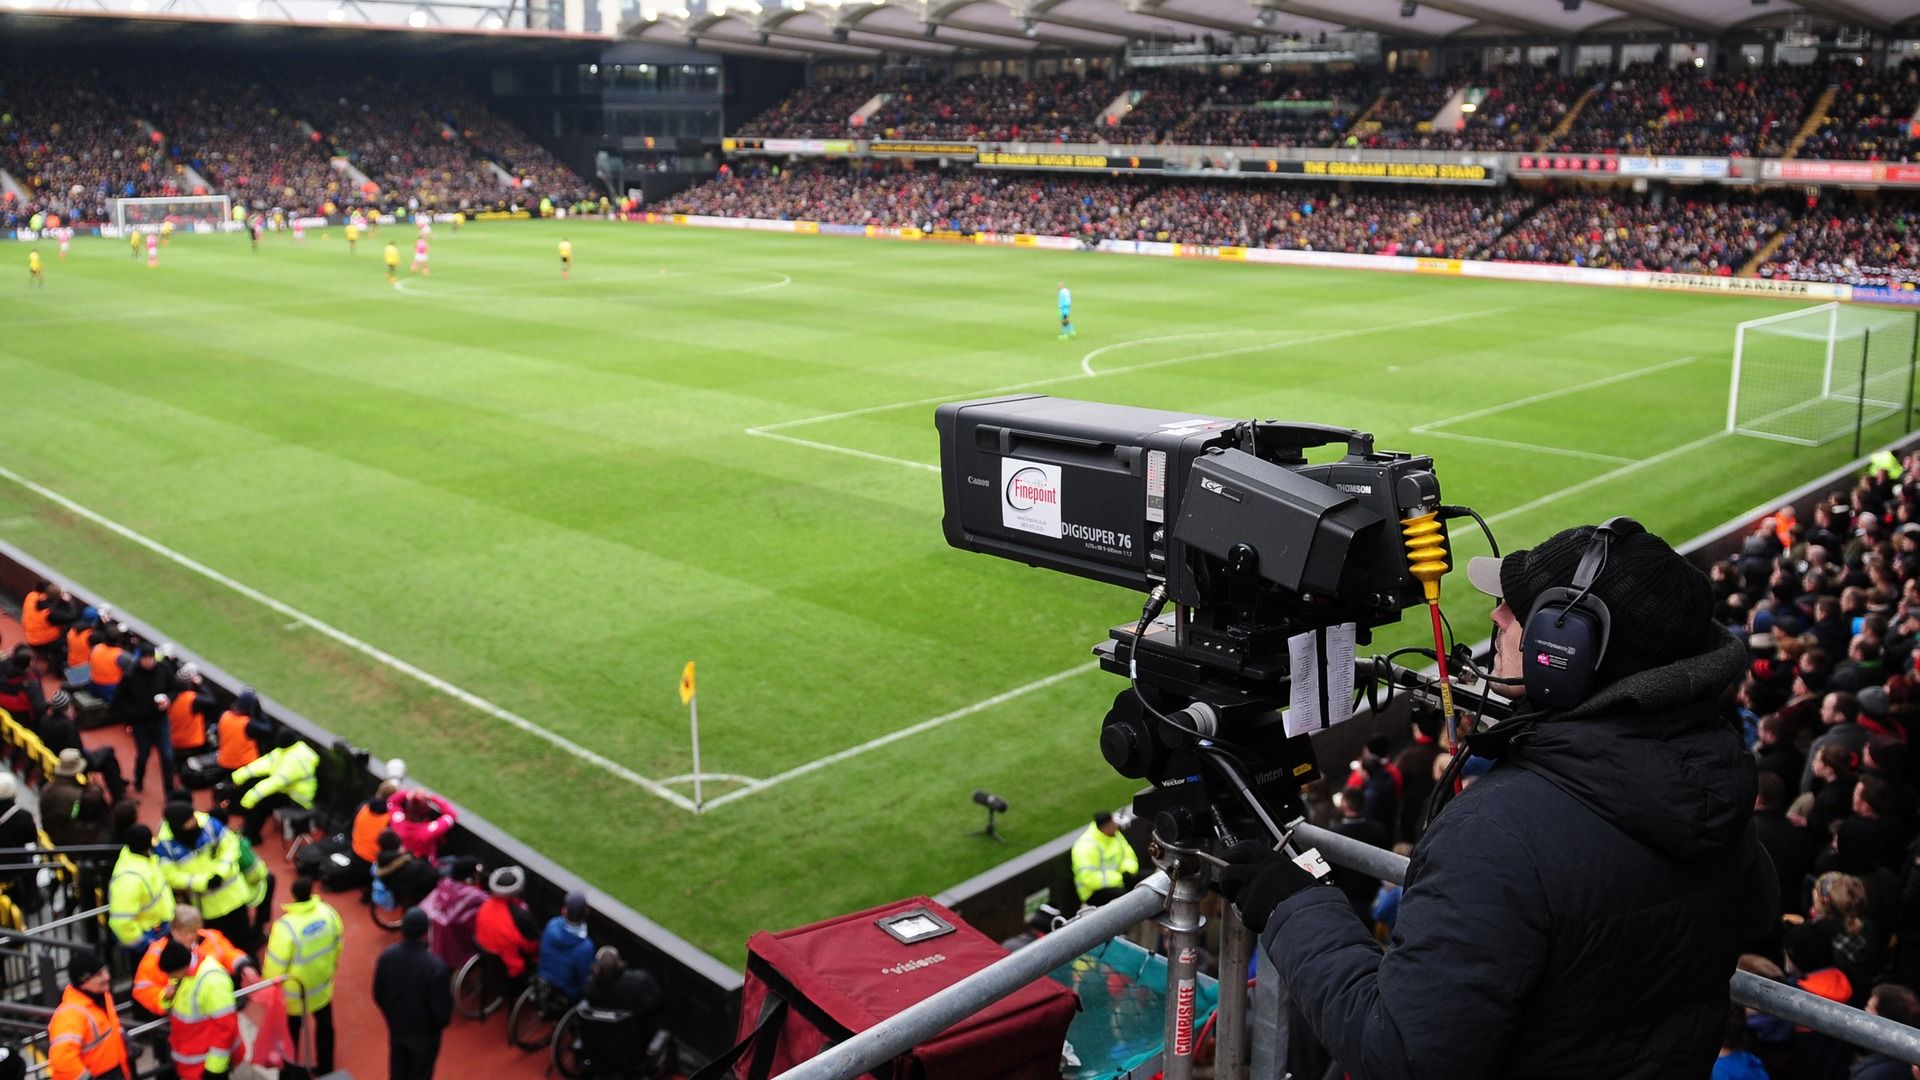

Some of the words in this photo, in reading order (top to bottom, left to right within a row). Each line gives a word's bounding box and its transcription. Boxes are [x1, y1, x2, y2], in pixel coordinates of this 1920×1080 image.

[1303, 161, 1327, 175] THE
[1328, 162, 1386, 176] GRAHAM
[1387, 163, 1437, 178] TAYLOR
[1438, 164, 1485, 180] STAND
[967, 475, 990, 487] Canon
[1336, 484, 1371, 494] THOMSON
[1014, 479, 1057, 505] Finepoint
[1061, 522, 1115, 546] DIGISUPER
[1117, 533, 1132, 549] 76
[1161, 777, 1185, 787] Vector
[1255, 767, 1284, 784] Vinten
[1176, 986, 1194, 1054] COMBISAFE
